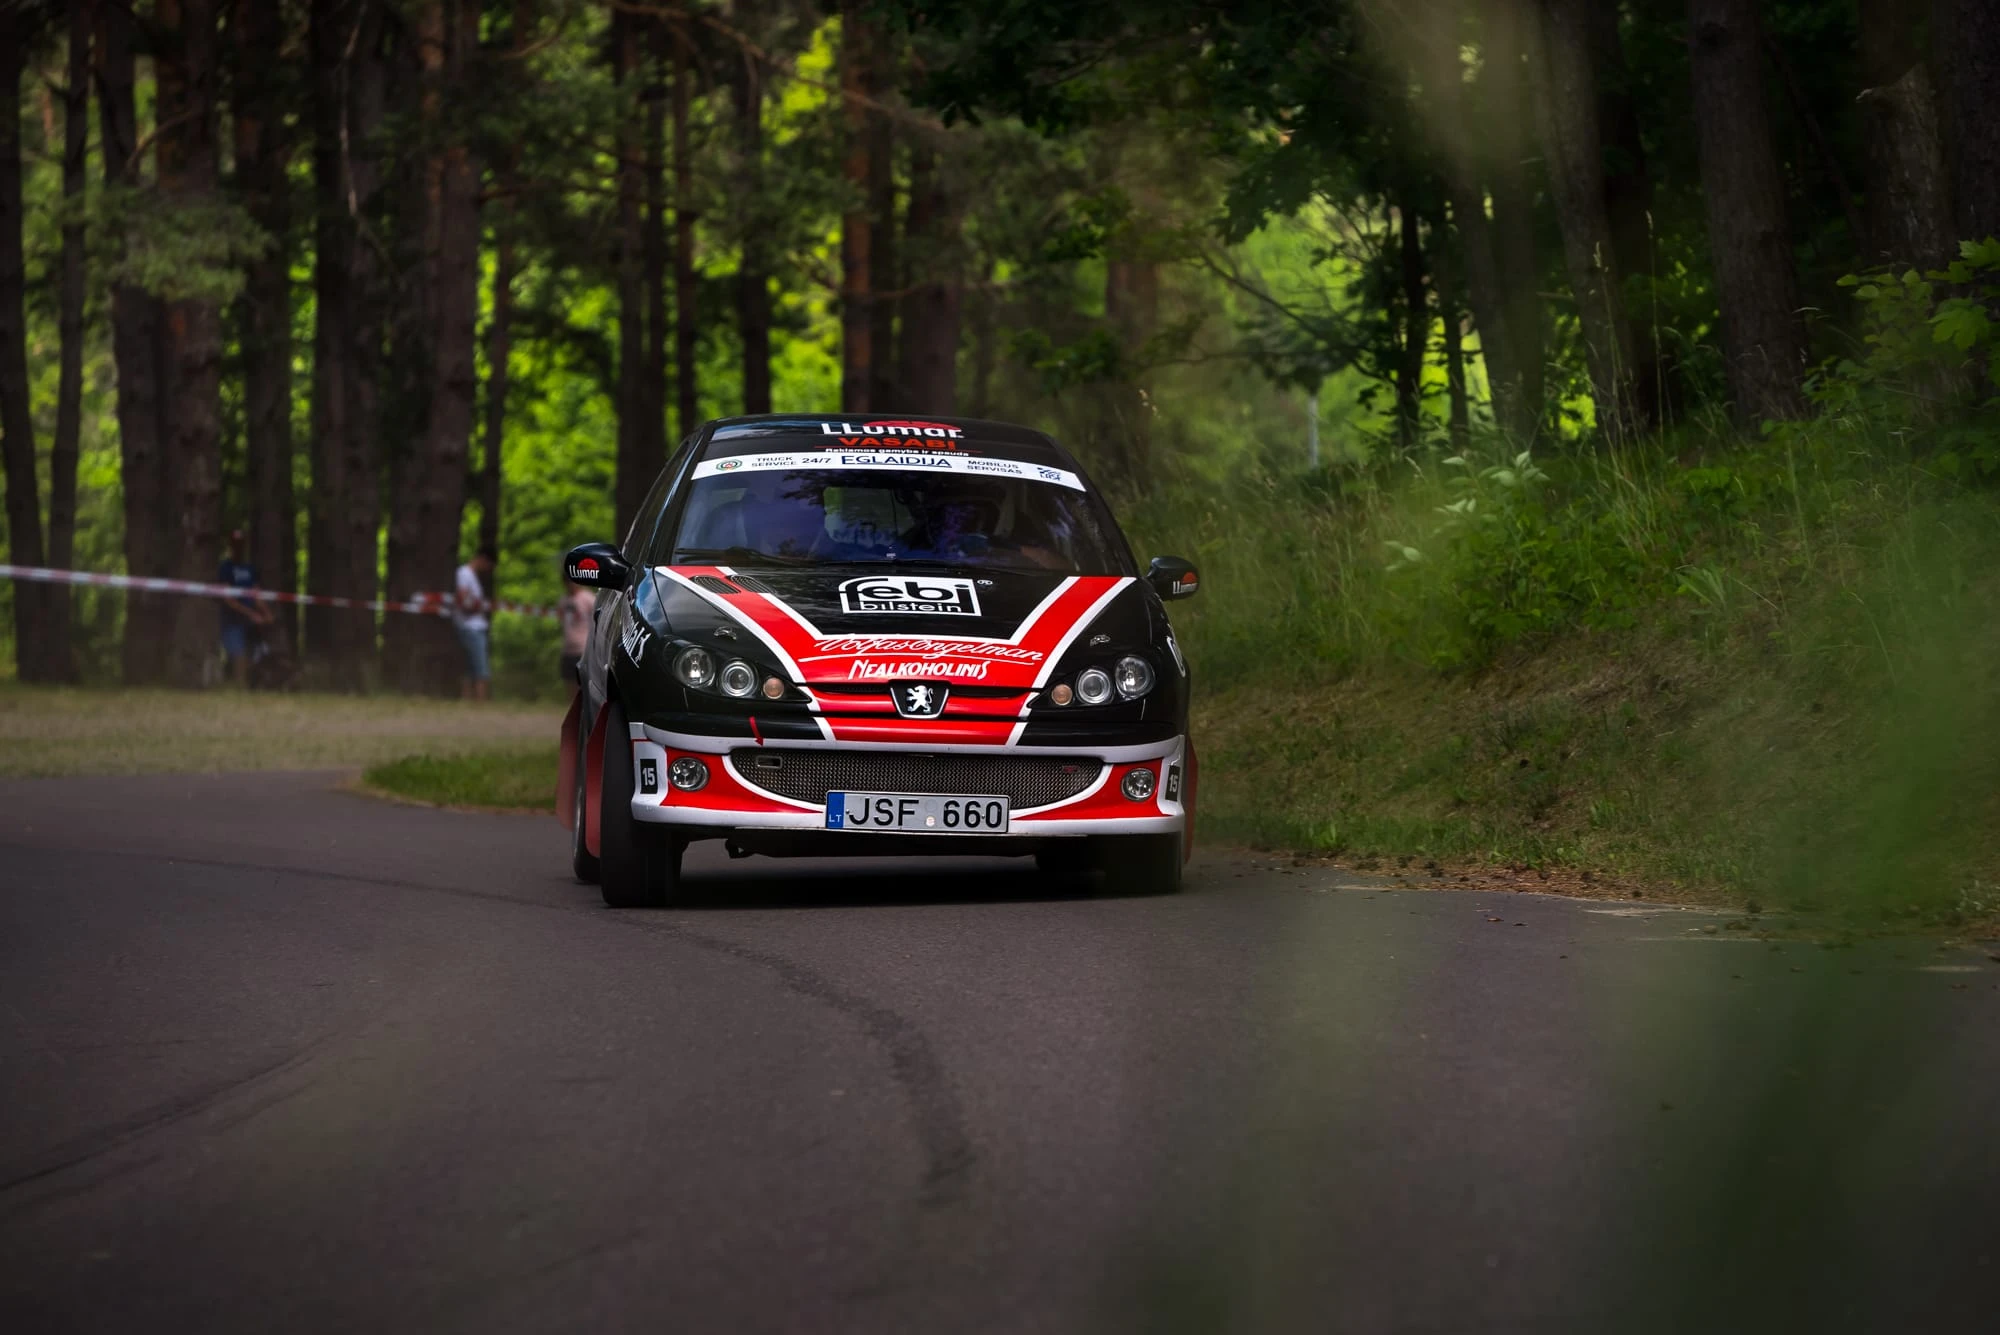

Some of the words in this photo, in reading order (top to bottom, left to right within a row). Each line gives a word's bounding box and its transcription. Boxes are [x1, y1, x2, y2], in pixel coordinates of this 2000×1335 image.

[821, 423, 965, 439] LLumar
[838, 437, 957, 450] VASABI
[842, 455, 952, 468] EGLAIDIJA
[967, 460, 1019, 469] MOBILUS
[966, 465, 1023, 475] SERVISAS
[840, 577, 976, 608] febi
[860, 600, 962, 613] bilstein
[642, 767, 655, 786] 15
[1169, 774, 1178, 793] 15
[828, 814, 842, 823] LT
[849, 797, 919, 827] JSF
[943, 800, 1002, 828] 660
